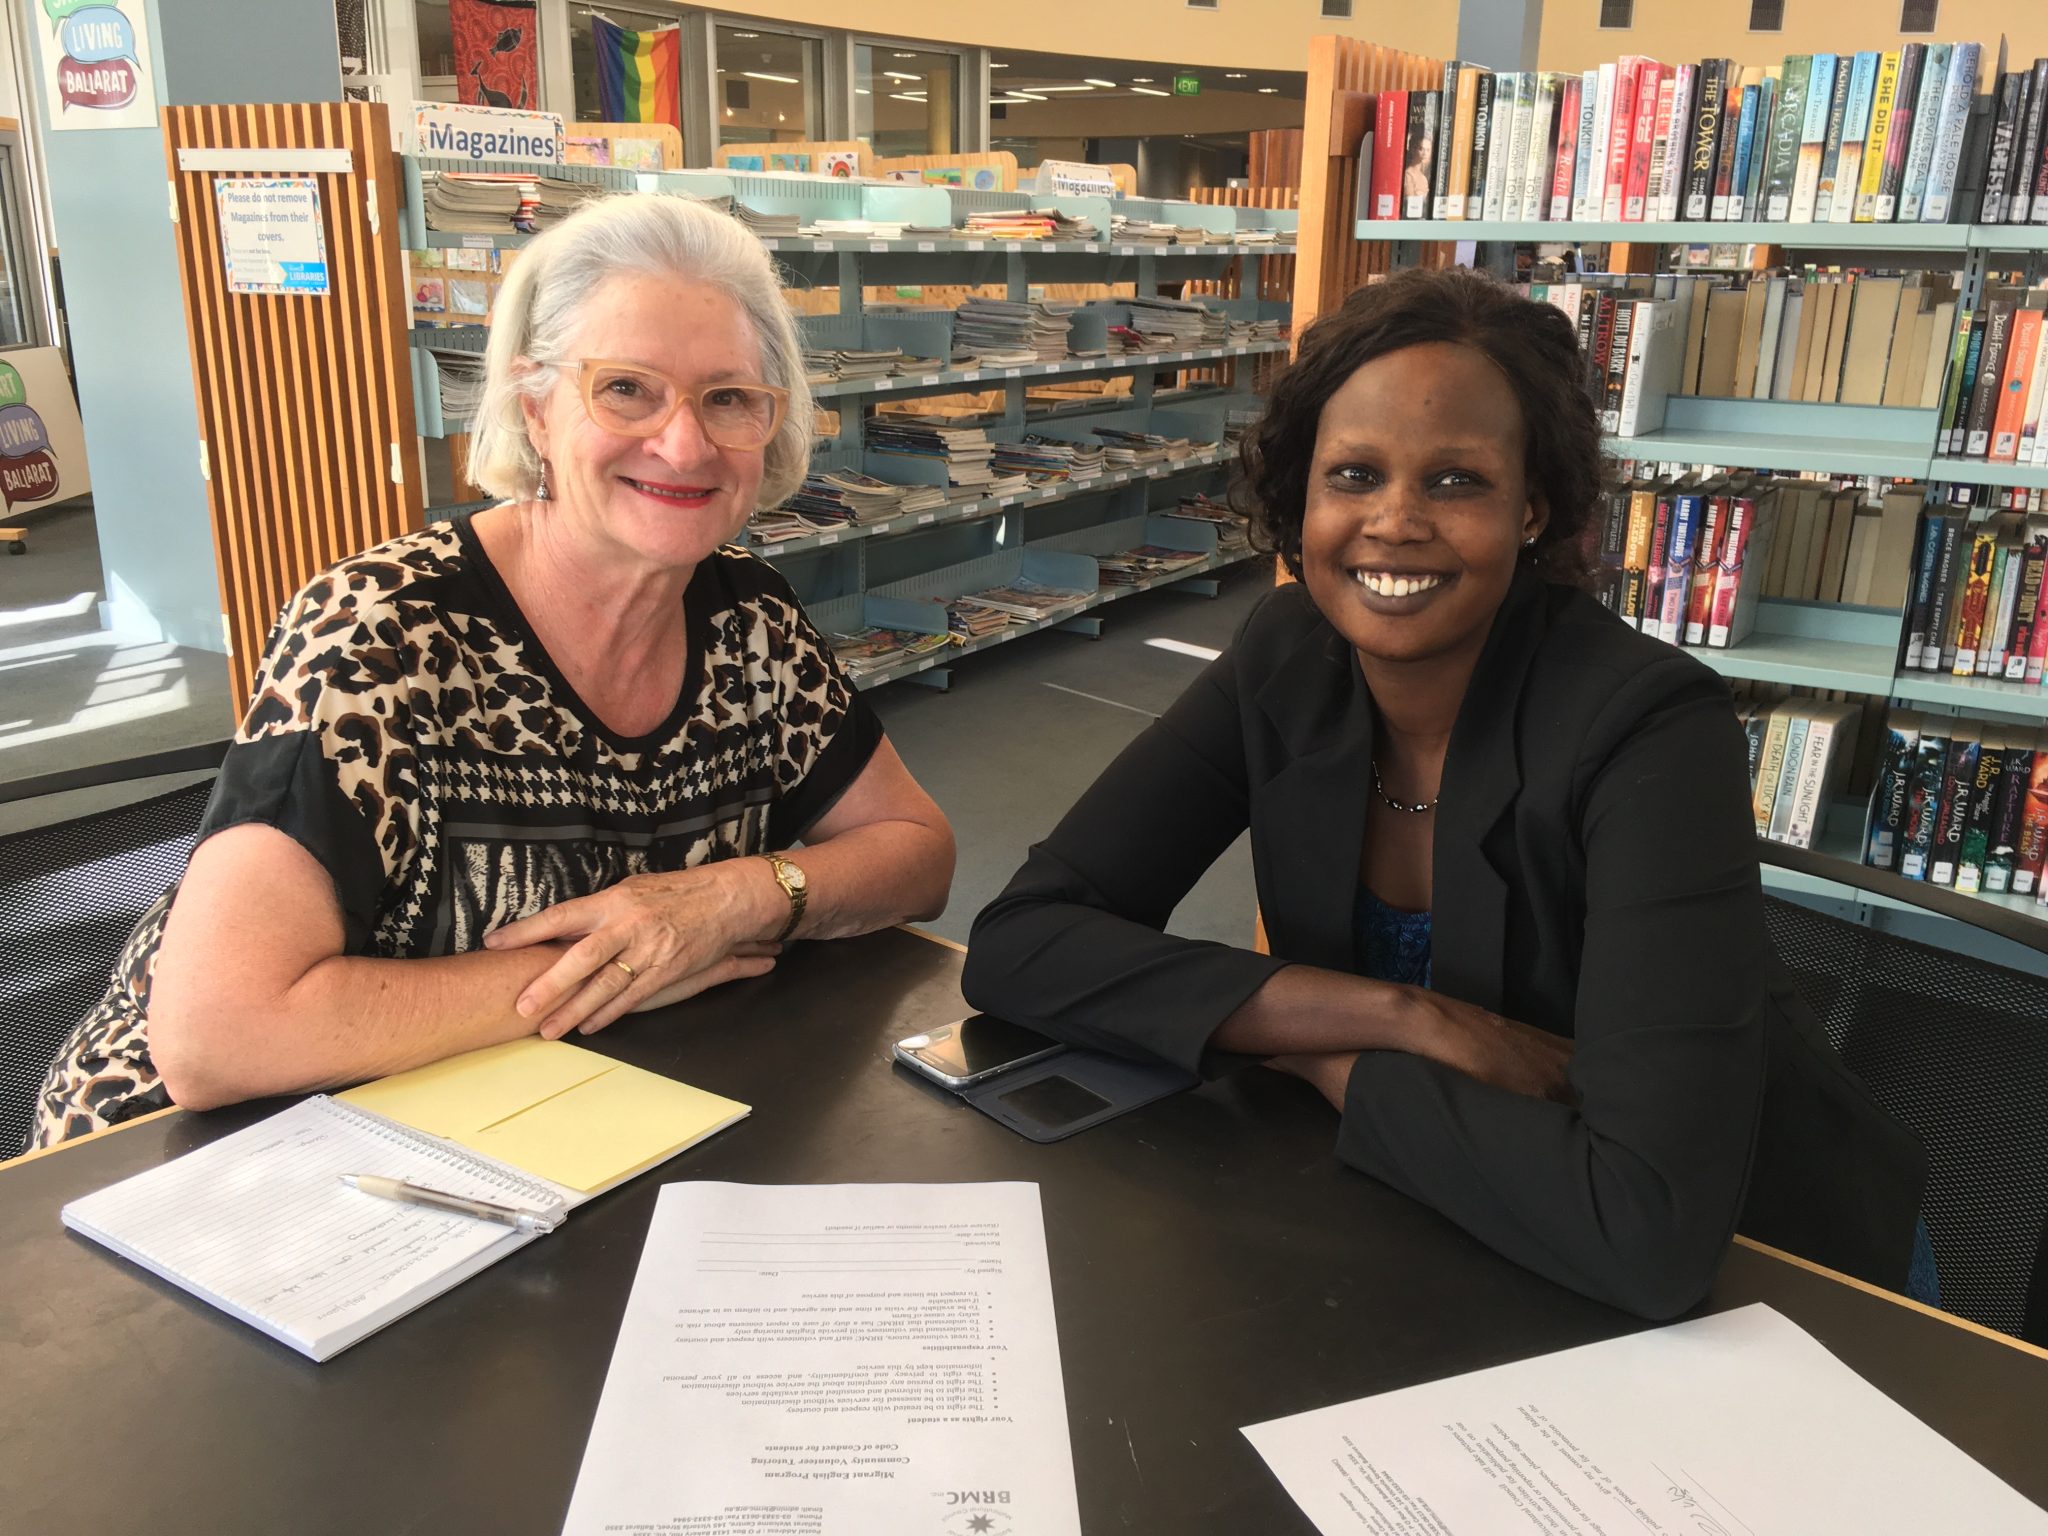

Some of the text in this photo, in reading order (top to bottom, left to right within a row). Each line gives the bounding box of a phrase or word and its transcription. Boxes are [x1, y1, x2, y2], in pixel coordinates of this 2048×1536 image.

[72, 22, 122, 52] LIVING
[1886, 58, 1897, 71] IF
[66, 70, 128, 94] BALLARAT
[1183, 80, 1198, 93] EXIT
[1479, 78, 1490, 104] PETER
[1880, 76, 1894, 104] SHE
[1810, 60, 1828, 138] Rachael Treasure
[1828, 60, 1850, 152] RACHAEL TREASURE
[1850, 58, 1870, 137] Rachael Treasure
[1474, 105, 1488, 150] TONKIN
[1581, 104, 1594, 151] TONKIN
[1694, 76, 1720, 172] THE TOWER
[1874, 109, 1889, 134] DID
[1914, 77, 1943, 184] THE DEVIL'S SEAL
[1940, 50, 1976, 192] BEHOLD A PALE HORSE
[430, 122, 554, 158] Magazines
[1510, 112, 1522, 170] TESTIMONY
[1612, 128, 1627, 163] FALL
[1871, 140, 1882, 153] IT
[228, 192, 308, 203] Please do not remove
[1057, 173, 1110, 196] Magazines
[230, 212, 309, 224] Magazines from their
[258, 234, 284, 242] covers.
[290, 272, 324, 281] LIBRARIES
[1614, 308, 1632, 334] HOTEL
[1992, 314, 2008, 340] DEATH
[2020, 322, 2035, 348] DEATH
[1594, 320, 1610, 366] TROW
[1613, 334, 1628, 347] DU
[1610, 348, 1626, 374] BARRY
[1960, 396, 1968, 414] BORIS
[1980, 386, 1989, 412] MARCO
[0, 417, 40, 449] LIVING
[3, 462, 52, 492] BALLARAT
[1608, 498, 1622, 552] HARRY TURTLEDOVE
[1628, 498, 1642, 562] TURTLEDOVE
[1638, 516, 1647, 546] HARRY
[1652, 502, 1668, 566] HARRY TURTLEDOVE
[1674, 498, 1691, 558] HARRY TURTLEDOVE
[1700, 504, 1718, 563] HARRY TURTLEDOVE
[1726, 506, 1744, 570] HARRY TURTLEDOVE
[1939, 528, 1955, 583] BRUCE WAGNER
[1920, 571, 1930, 604] WAGNER
[1932, 592, 1944, 630] THE EMPTY
[1748, 734, 1759, 762] JOHN
[1771, 743, 1783, 771] DEATH
[1810, 735, 1824, 758] FEAR
[1766, 774, 1774, 782] OF
[1782, 732, 1804, 796] LONDON RAIN
[1808, 767, 1818, 778] THE
[1976, 754, 1992, 788] WARD
[2006, 763, 2031, 774] WARD
[1761, 784, 1773, 808] LUCY
[1798, 779, 1816, 824] SUNLIGHT
[1887, 790, 1903, 827] WARD
[2000, 774, 2020, 842] RAPTURE
[1756, 810, 1769, 832] KYTE
[1916, 808, 1933, 844] WARD
[1946, 800, 1967, 843] WARD
[2020, 812, 2035, 855] THE BEAST
[2028, 826, 2044, 861] WARD
[922, 1344, 984, 1352] responsibilities
[786, 1406, 821, 1414] courtesy
[841, 1405, 871, 1413] respect
[962, 1415, 988, 1423] rights
[751, 1456, 910, 1466] Community Volunteer Tutoring
[821, 1444, 861, 1452] Conduct
[764, 1471, 894, 1480] Migrant English Program
[946, 1490, 1011, 1505] BRMC
